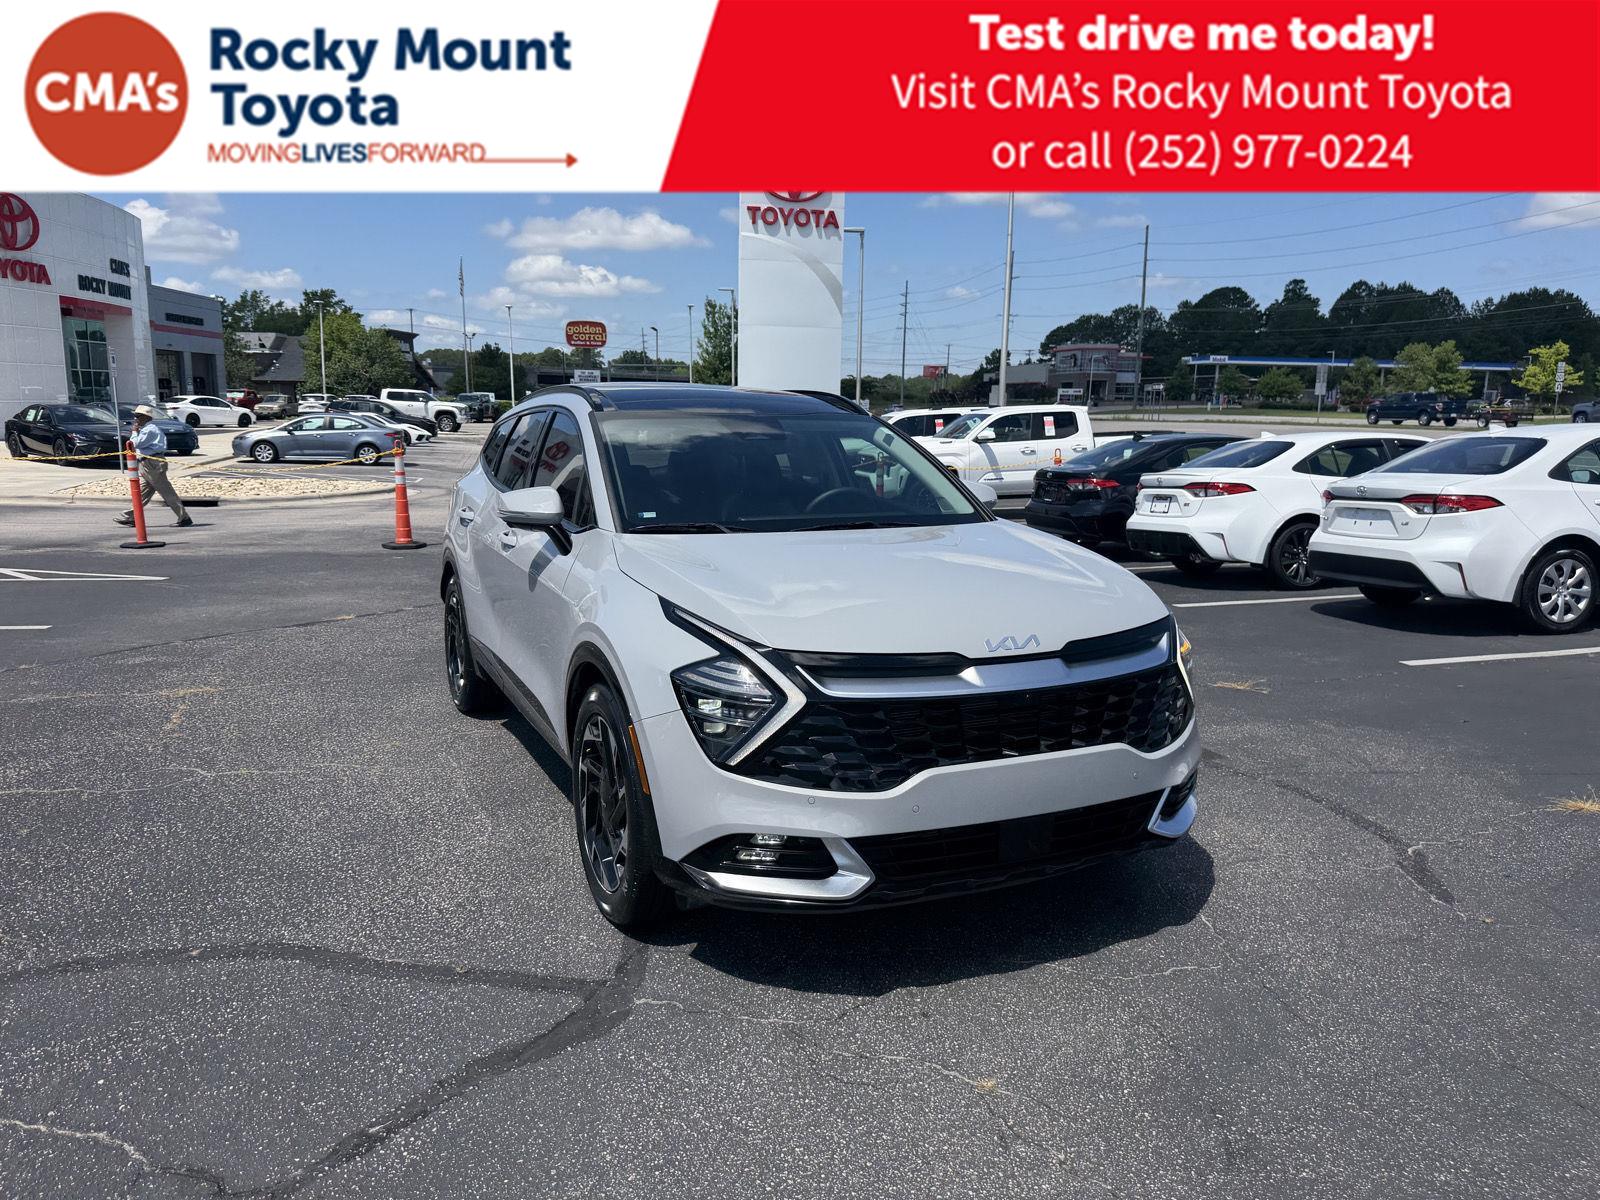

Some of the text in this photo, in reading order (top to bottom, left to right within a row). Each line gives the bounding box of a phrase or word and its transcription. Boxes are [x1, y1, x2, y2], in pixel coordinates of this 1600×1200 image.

[747, 206, 839, 228] TOYOTA
[78, 275, 106, 294] ROCKY
[567, 325, 602, 334] golden
[573, 333, 606, 341] corral
[984, 634, 1041, 652] KIA
